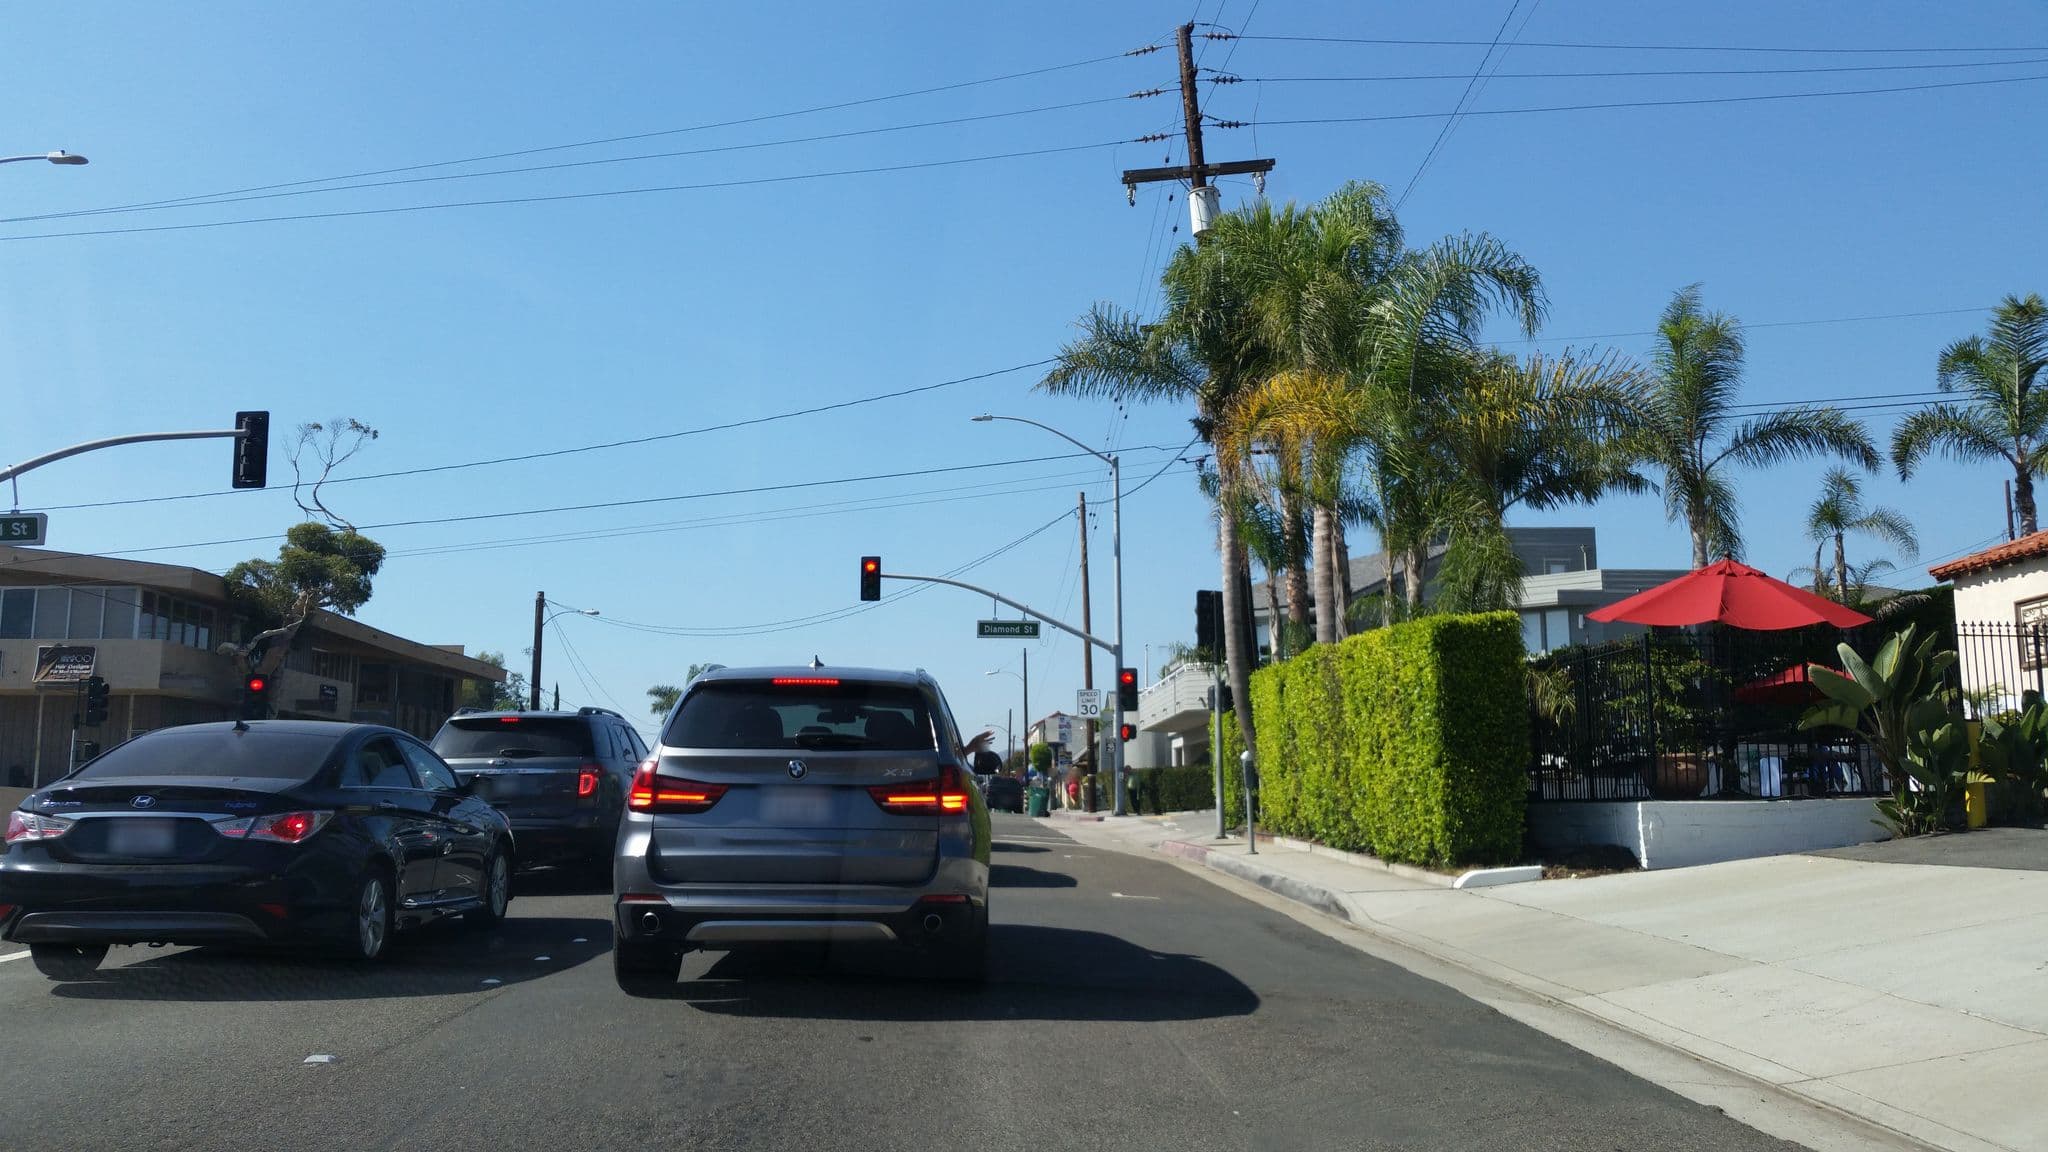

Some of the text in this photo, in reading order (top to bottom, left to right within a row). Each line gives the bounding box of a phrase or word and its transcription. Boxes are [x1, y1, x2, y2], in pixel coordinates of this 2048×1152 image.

[11, 522, 27, 536] St
[984, 625, 1033, 634] Diamond St
[1081, 705, 1098, 715] 30
